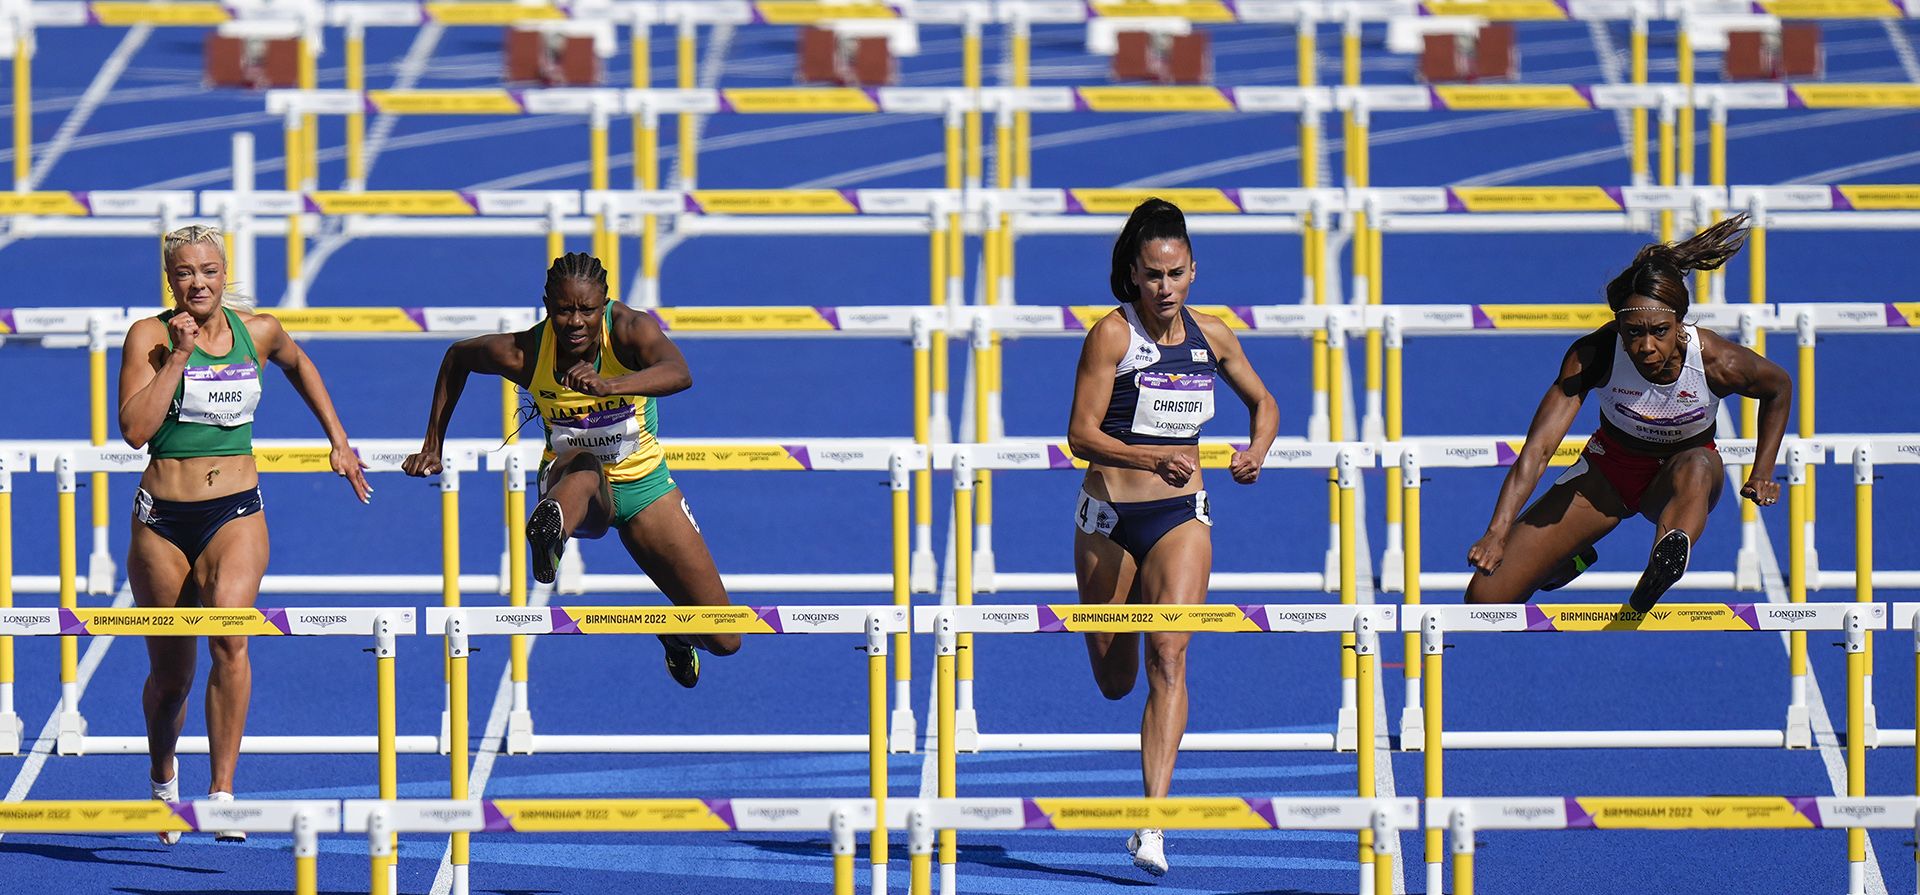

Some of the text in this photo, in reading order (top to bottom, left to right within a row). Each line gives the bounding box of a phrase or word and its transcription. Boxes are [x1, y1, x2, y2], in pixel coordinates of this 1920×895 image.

[208, 391, 242, 403] MARRS
[1153, 399, 1203, 413] CHRISTOFI
[1156, 421, 1197, 431] LONGINES
[1636, 425, 1682, 436] SEMBER
[567, 433, 623, 448] WILLIAMS
[101, 453, 143, 461] LONGINES
[685, 451, 706, 461] 2022
[821, 451, 864, 459] LONGINES
[997, 452, 1040, 460] LONGINES
[1269, 450, 1312, 459] LONGINES
[1445, 449, 1488, 457] LONGINES
[1080, 497, 1089, 527] 4
[495, 614, 543, 622] LONGINES
[585, 614, 666, 624] BIRMINGHAM 2022
[792, 613, 840, 622] LONGINES
[982, 612, 1030, 620] LONGINES
[1072, 613, 1154, 622] BIRMINGHAM 2022
[1278, 612, 1326, 620] LONGINES
[1470, 610, 1518, 619] LONGINES
[1560, 611, 1642, 621] BIRMINGHAM 2022
[1767, 610, 1815, 619] LONGINES
[3, 616, 51, 624] LONGINES
[93, 616, 174, 626] BIRMINGHAM 2022
[300, 615, 348, 624] LONGINES
[1602, 806, 1694, 818] BIRMINGHAM 2022
